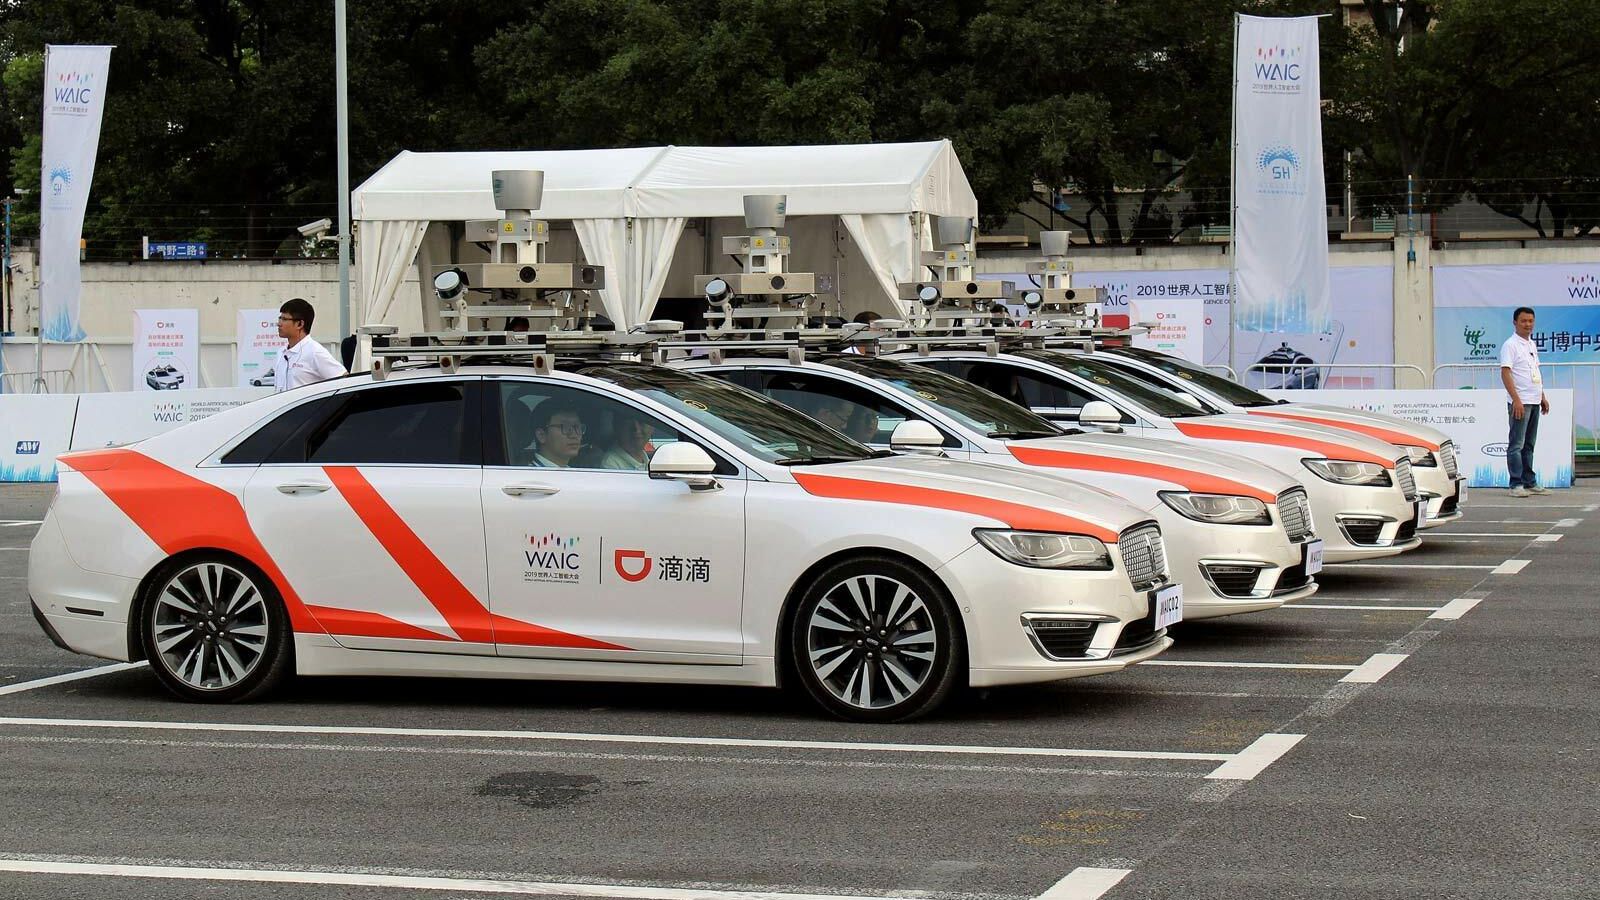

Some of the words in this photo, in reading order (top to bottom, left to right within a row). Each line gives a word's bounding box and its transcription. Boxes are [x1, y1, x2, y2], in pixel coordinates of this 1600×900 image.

[1255, 63, 1300, 80] WAIC
[55, 87, 91, 104] WAIC
[1104, 294, 1129, 307] AIC
[1568, 287, 1600, 299] WAI
[153, 412, 183, 422] WAIC
[524, 550, 580, 570] WAIC
[658, 556, 710, 583] 滴滴
